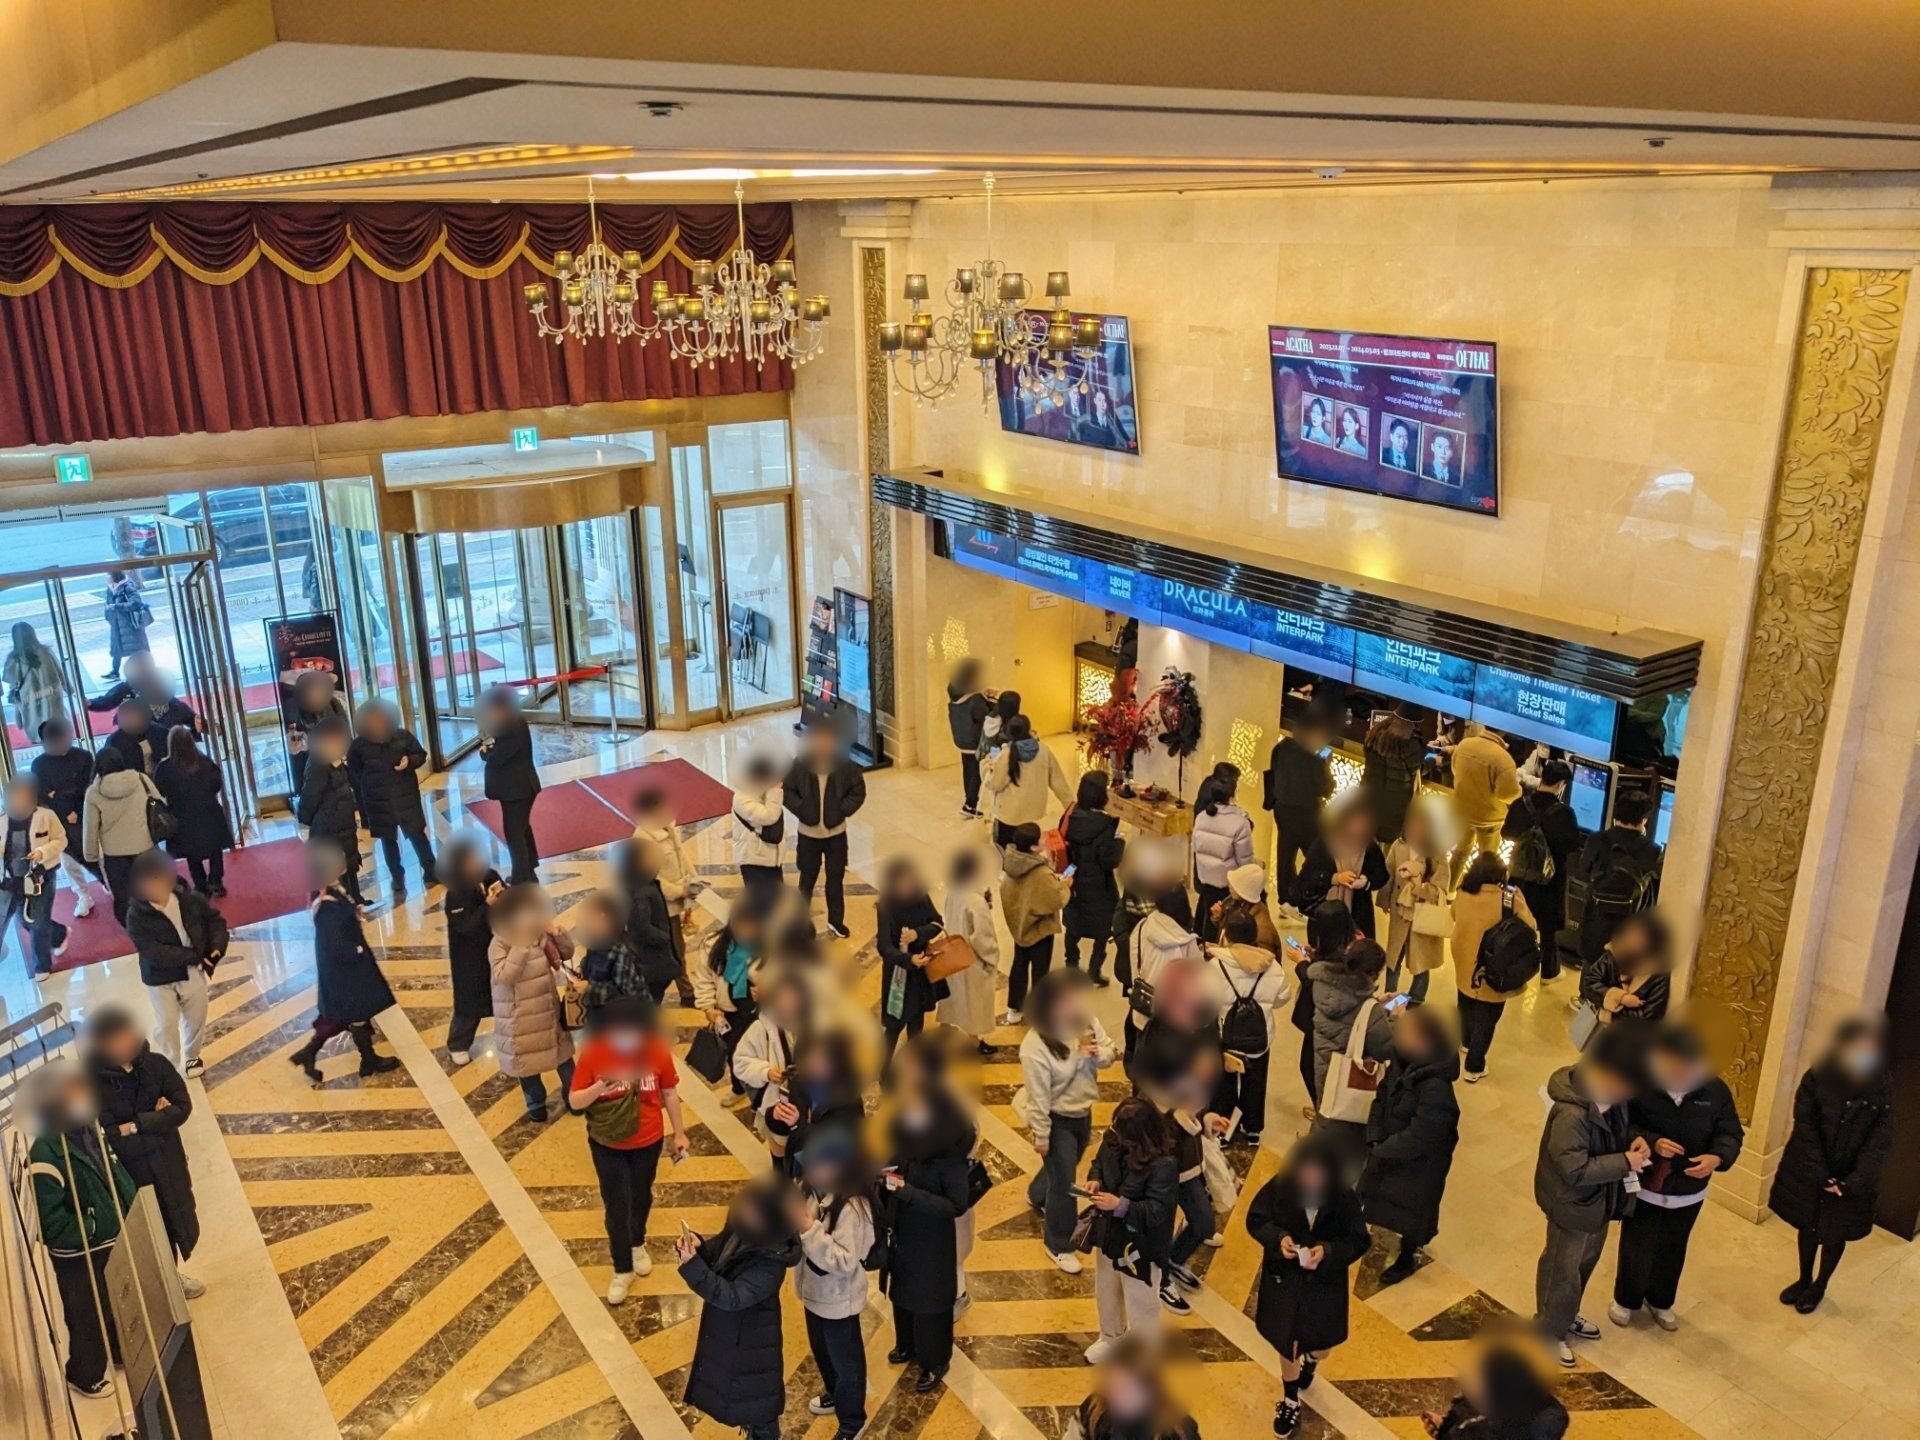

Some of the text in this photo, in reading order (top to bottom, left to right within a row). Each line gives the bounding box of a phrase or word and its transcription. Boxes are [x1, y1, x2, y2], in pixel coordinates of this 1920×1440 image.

[1285, 337, 1314, 354] AGATHA
[1456, 350, 1489, 370] 아가사
[1110, 576, 1131, 591] 네이버
[1110, 586, 1131, 599] NAVER
[1164, 579, 1248, 618] DRACULA
[1277, 609, 1326, 633] 인터파크
[1276, 622, 1324, 645] INTERPARK
[1386, 638, 1442, 664] 인터파크
[1385, 652, 1440, 677] INTERPARK
[1489, 665, 1601, 704] Charlotte Theater Ticket
[1517, 703, 1566, 725] Ticket Sales
[1518, 689, 1567, 716] 현장판매
